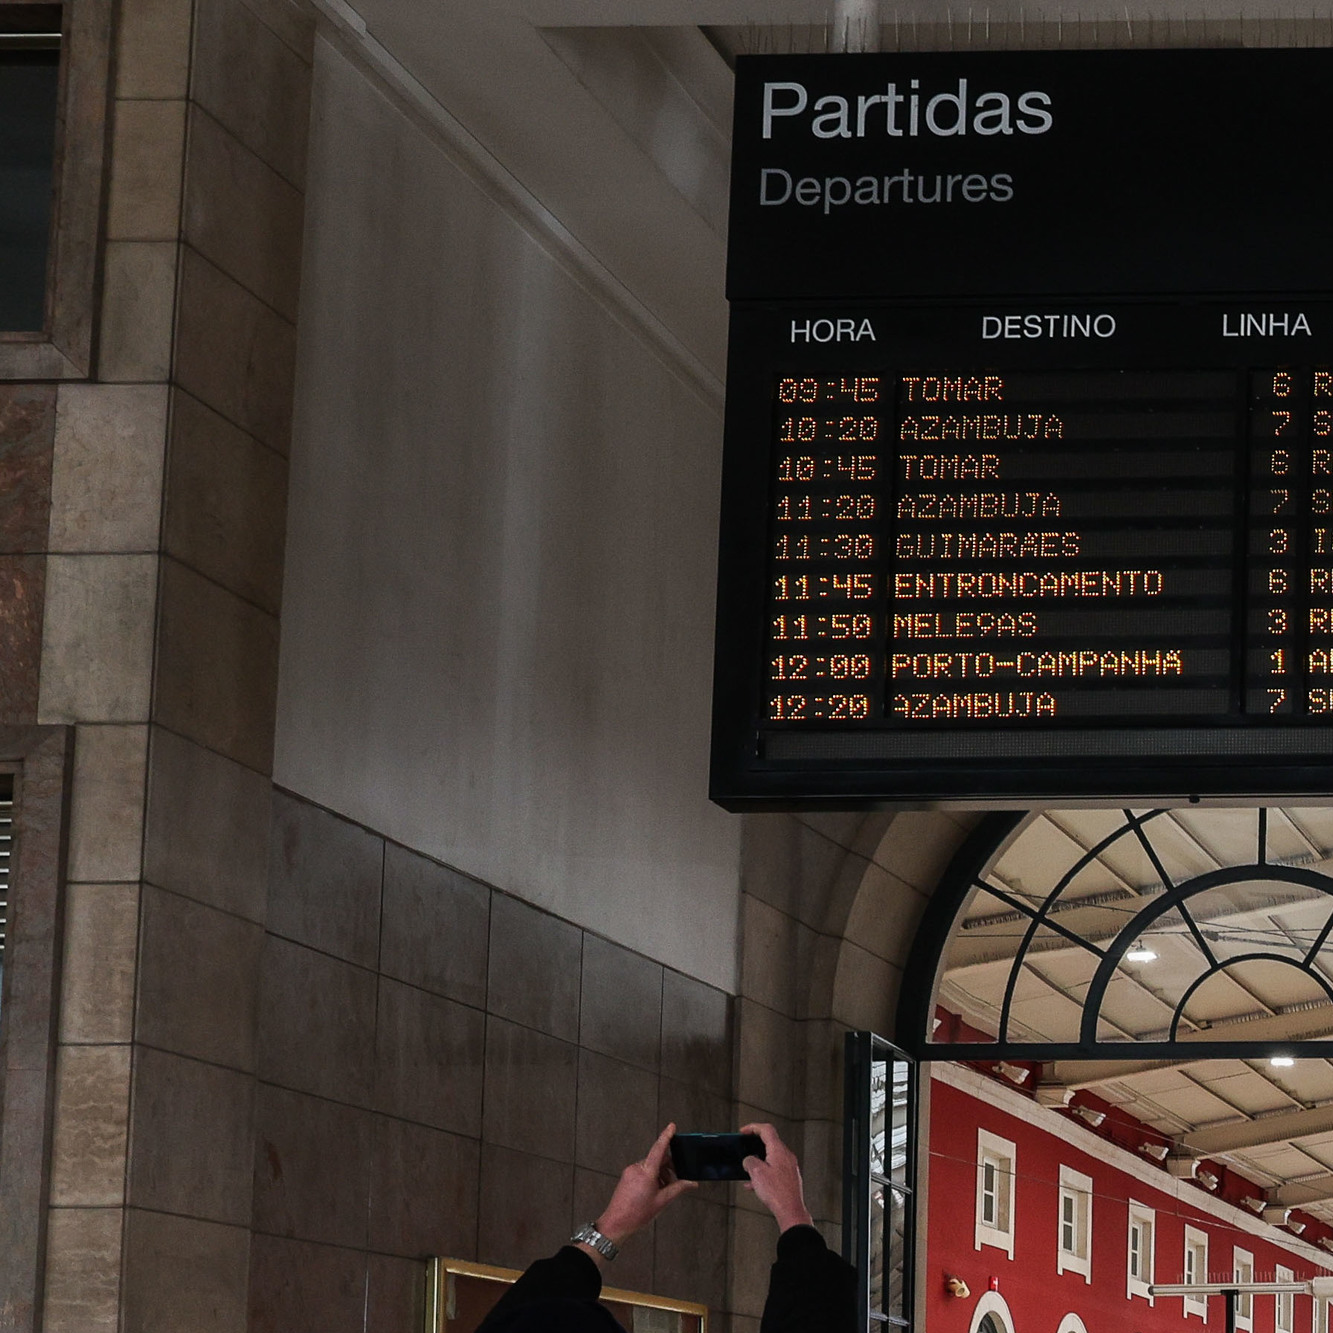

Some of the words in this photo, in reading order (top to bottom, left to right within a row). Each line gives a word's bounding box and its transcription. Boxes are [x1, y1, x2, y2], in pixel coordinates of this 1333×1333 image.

[763, 79, 1052, 138] Partidas
[760, 169, 1013, 214] Departures
[791, 319, 875, 342] HORA
[983, 315, 1115, 338] DESTINO
[1223, 314, 1311, 336] LINHA
[779, 378, 878, 402] 09:45
[903, 377, 1002, 401] TOMAR
[1273, 373, 1290, 396] 6
[776, 534, 872, 559] 11:30
[1270, 529, 1287, 553] 3
[775, 574, 872, 599] 11:45
[895, 571, 1162, 598] ENTRONCAMENTO
[1269, 569, 1287, 593] 6
[773, 614, 871, 639] 11:50
[1268, 609, 1286, 633] 3
[772, 655, 870, 679] 12:00
[1271, 649, 1285, 673] 1
